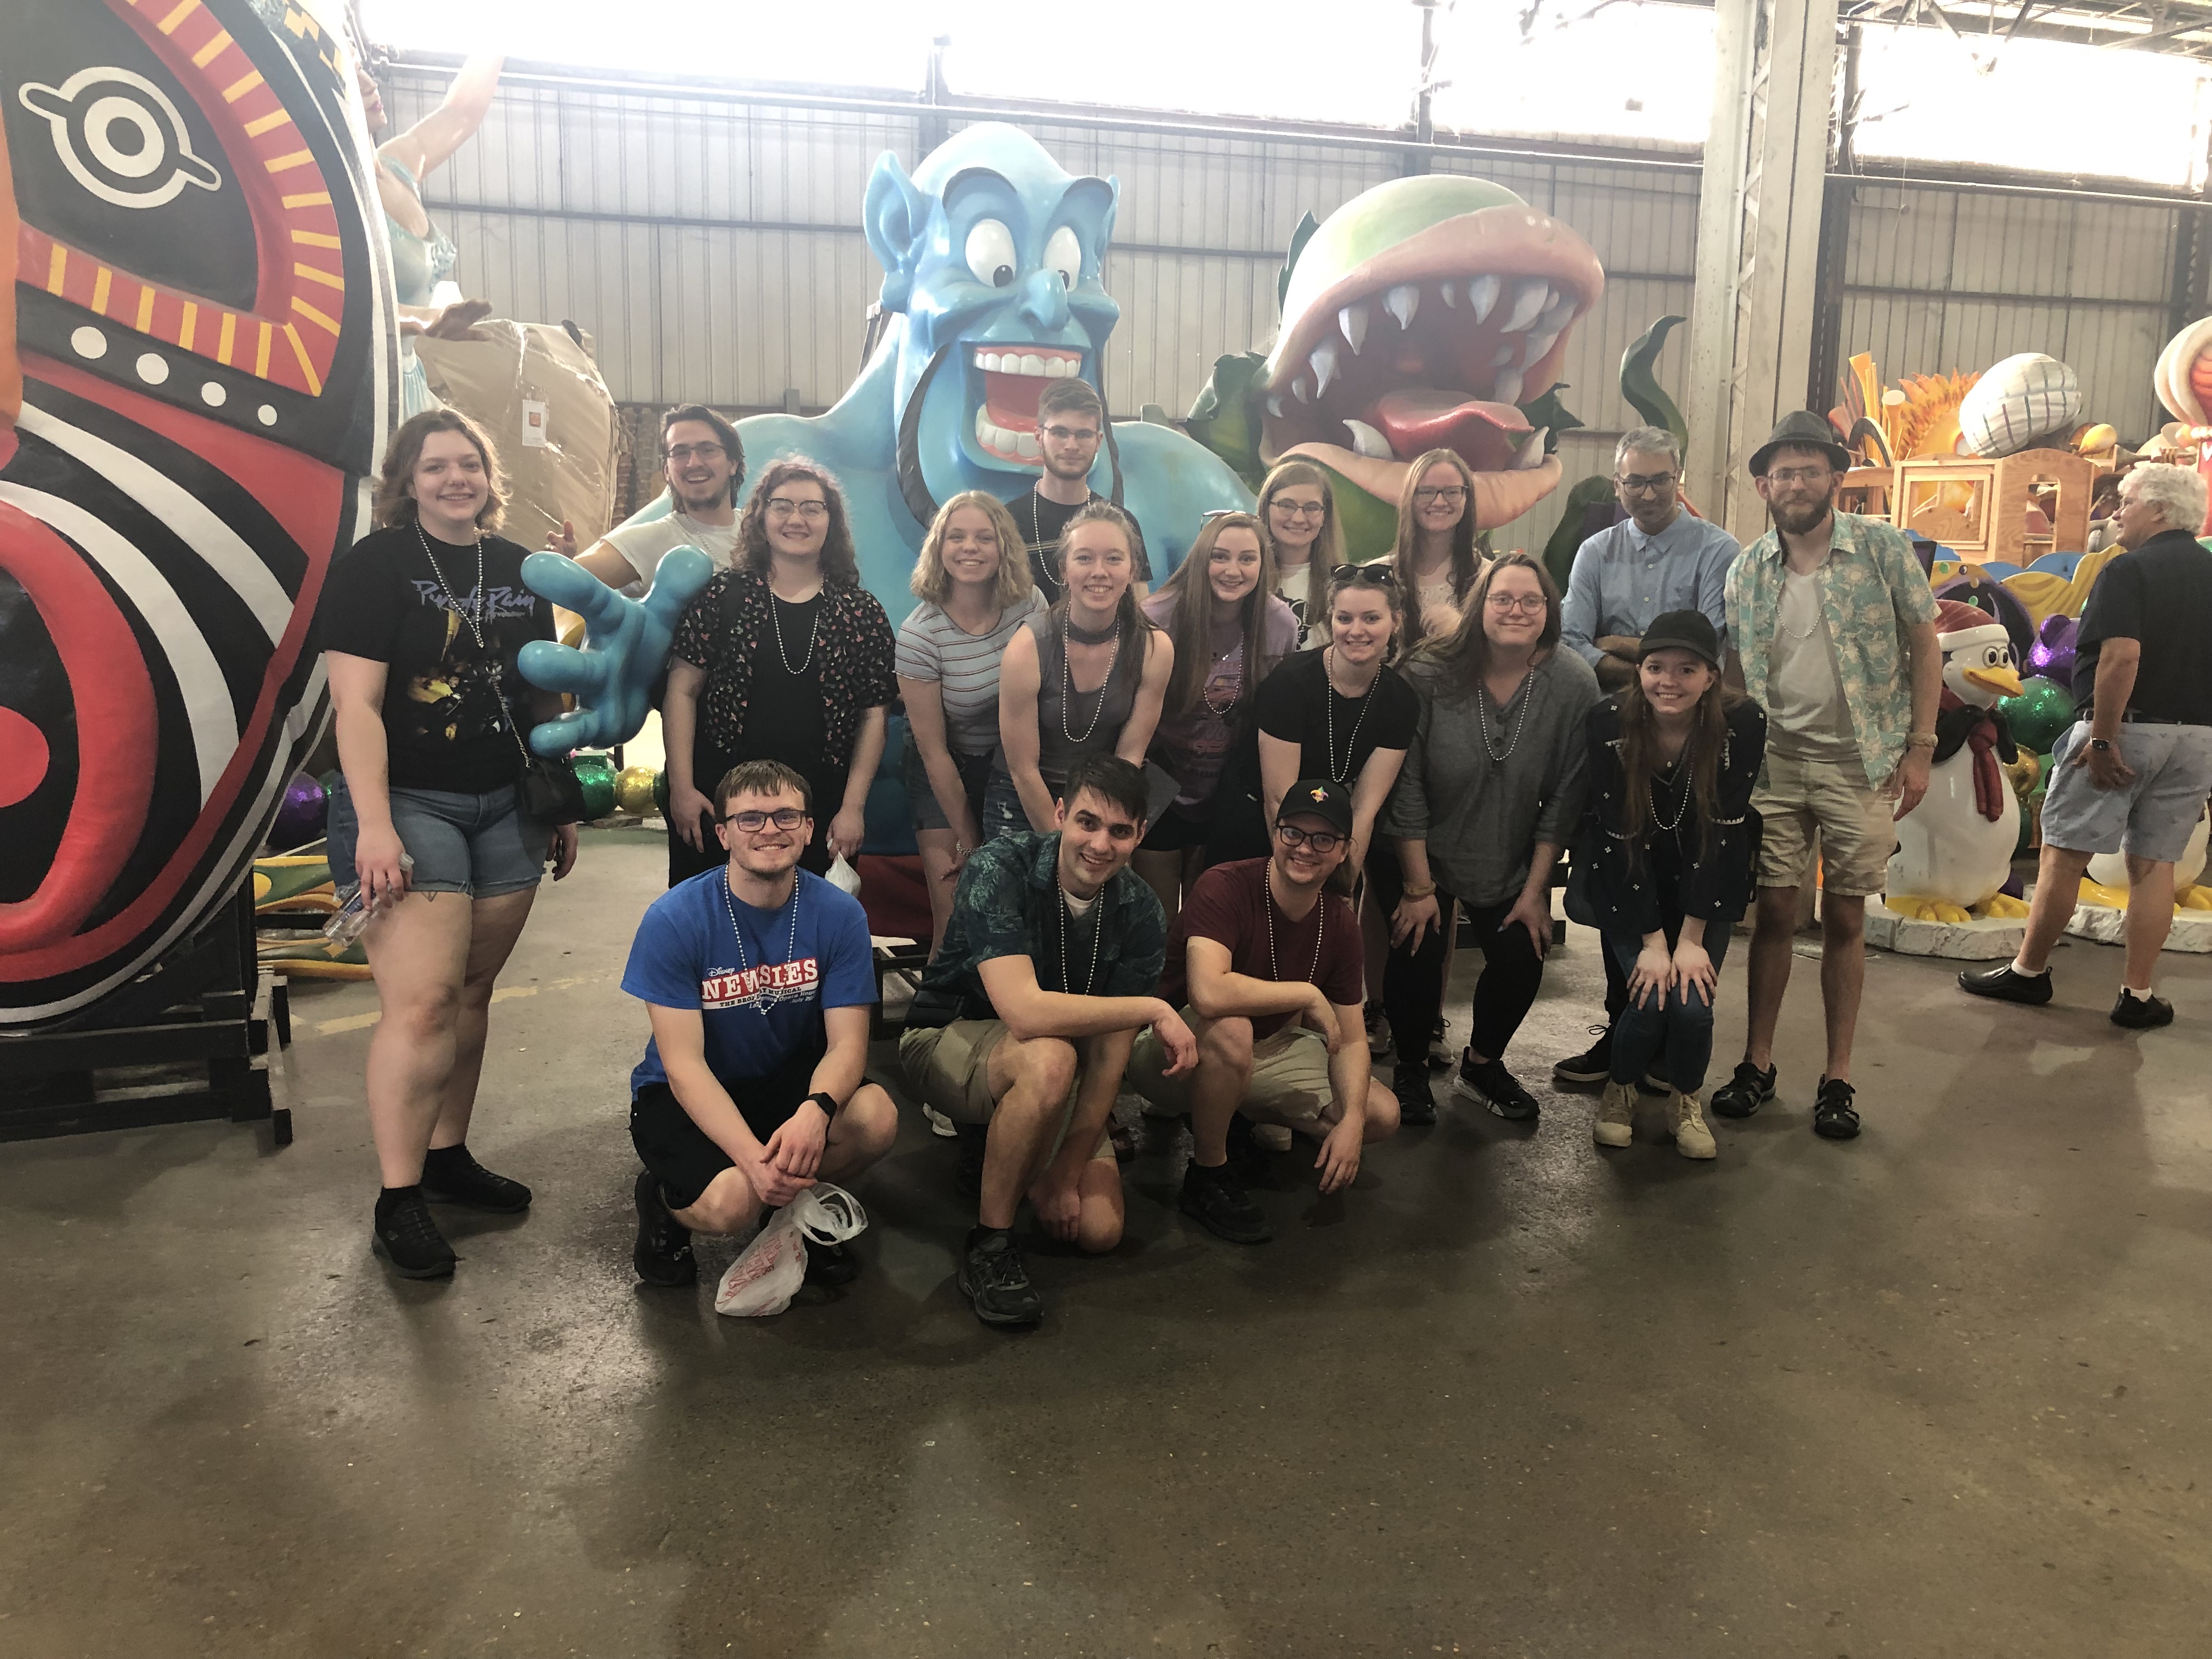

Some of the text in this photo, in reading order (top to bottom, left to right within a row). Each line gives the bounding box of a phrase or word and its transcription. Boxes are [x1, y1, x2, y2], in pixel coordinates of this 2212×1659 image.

[702, 958, 819, 1000] NEWSIES
[737, 988, 767, 1004] BROADAY
[768, 986, 802, 995] MUSICAL
